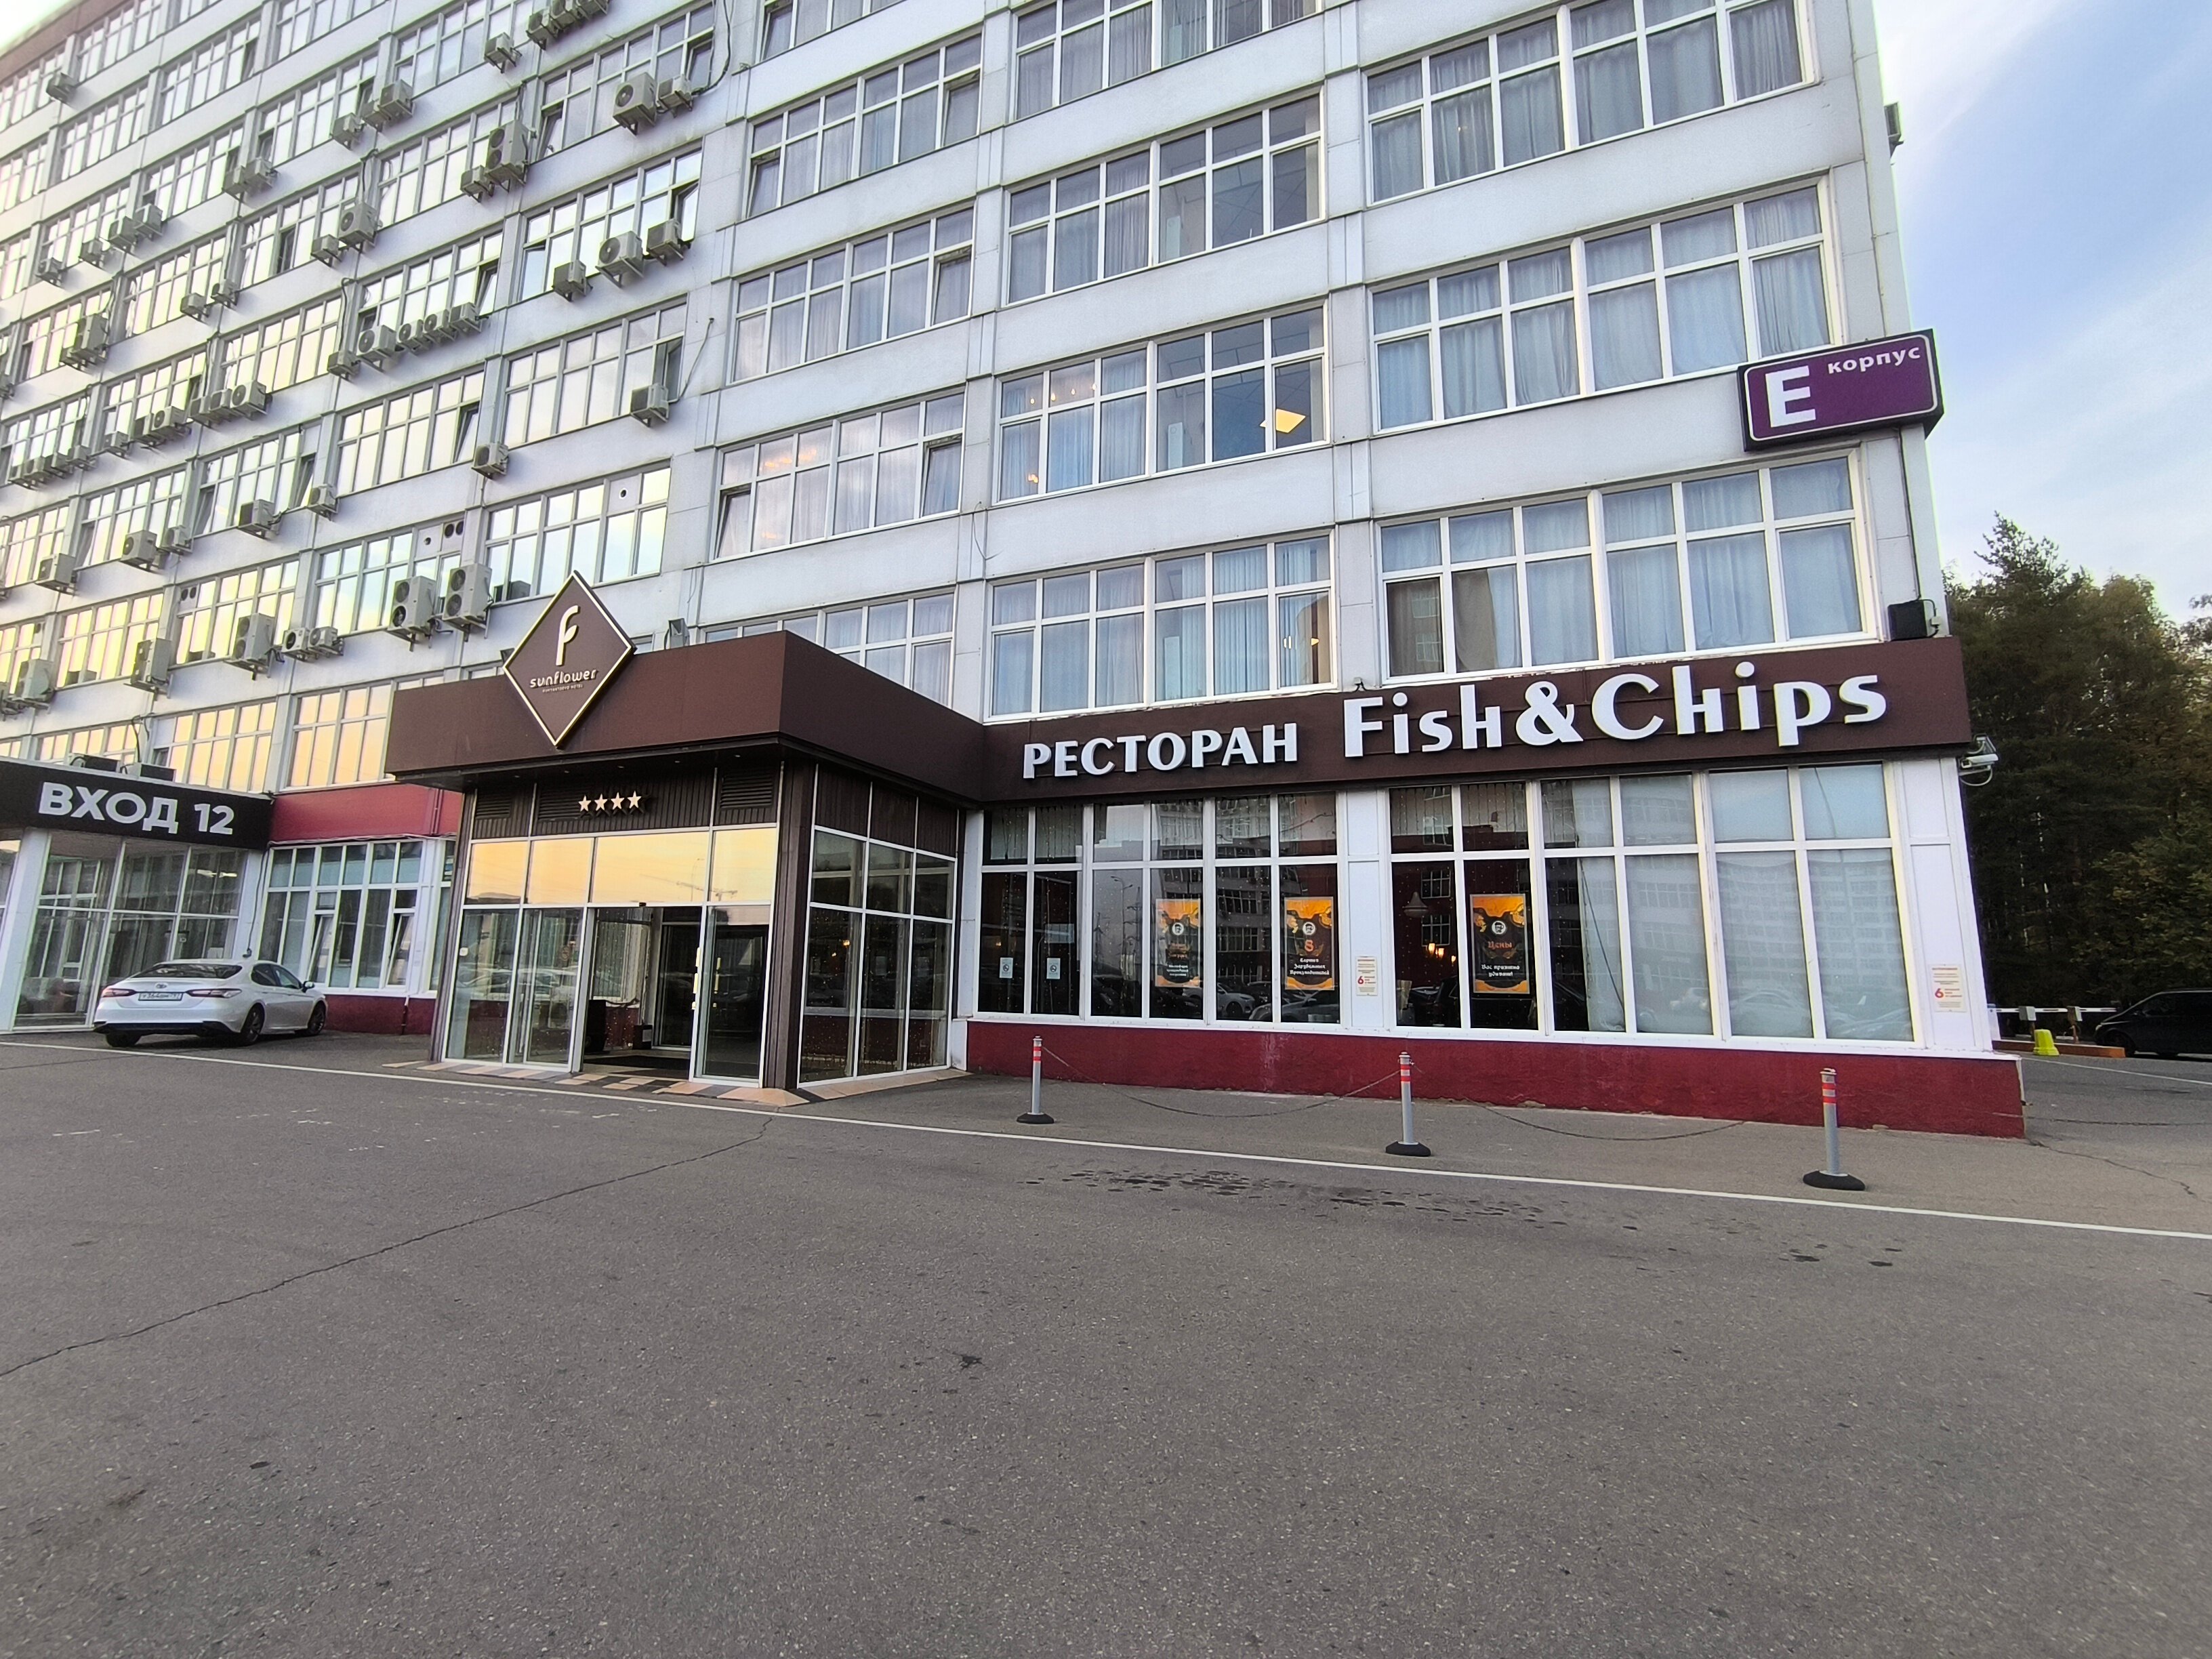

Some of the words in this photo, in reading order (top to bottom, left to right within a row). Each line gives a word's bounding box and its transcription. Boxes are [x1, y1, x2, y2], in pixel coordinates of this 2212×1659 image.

[1828, 347, 1921, 374] корпус
[1765, 365, 1816, 428] Е
[530, 670, 596, 688] sunflower
[1023, 722, 1298, 779] РЕСТОРАН
[39, 782, 179, 834] ВХОД
[194, 803, 235, 835] 12
